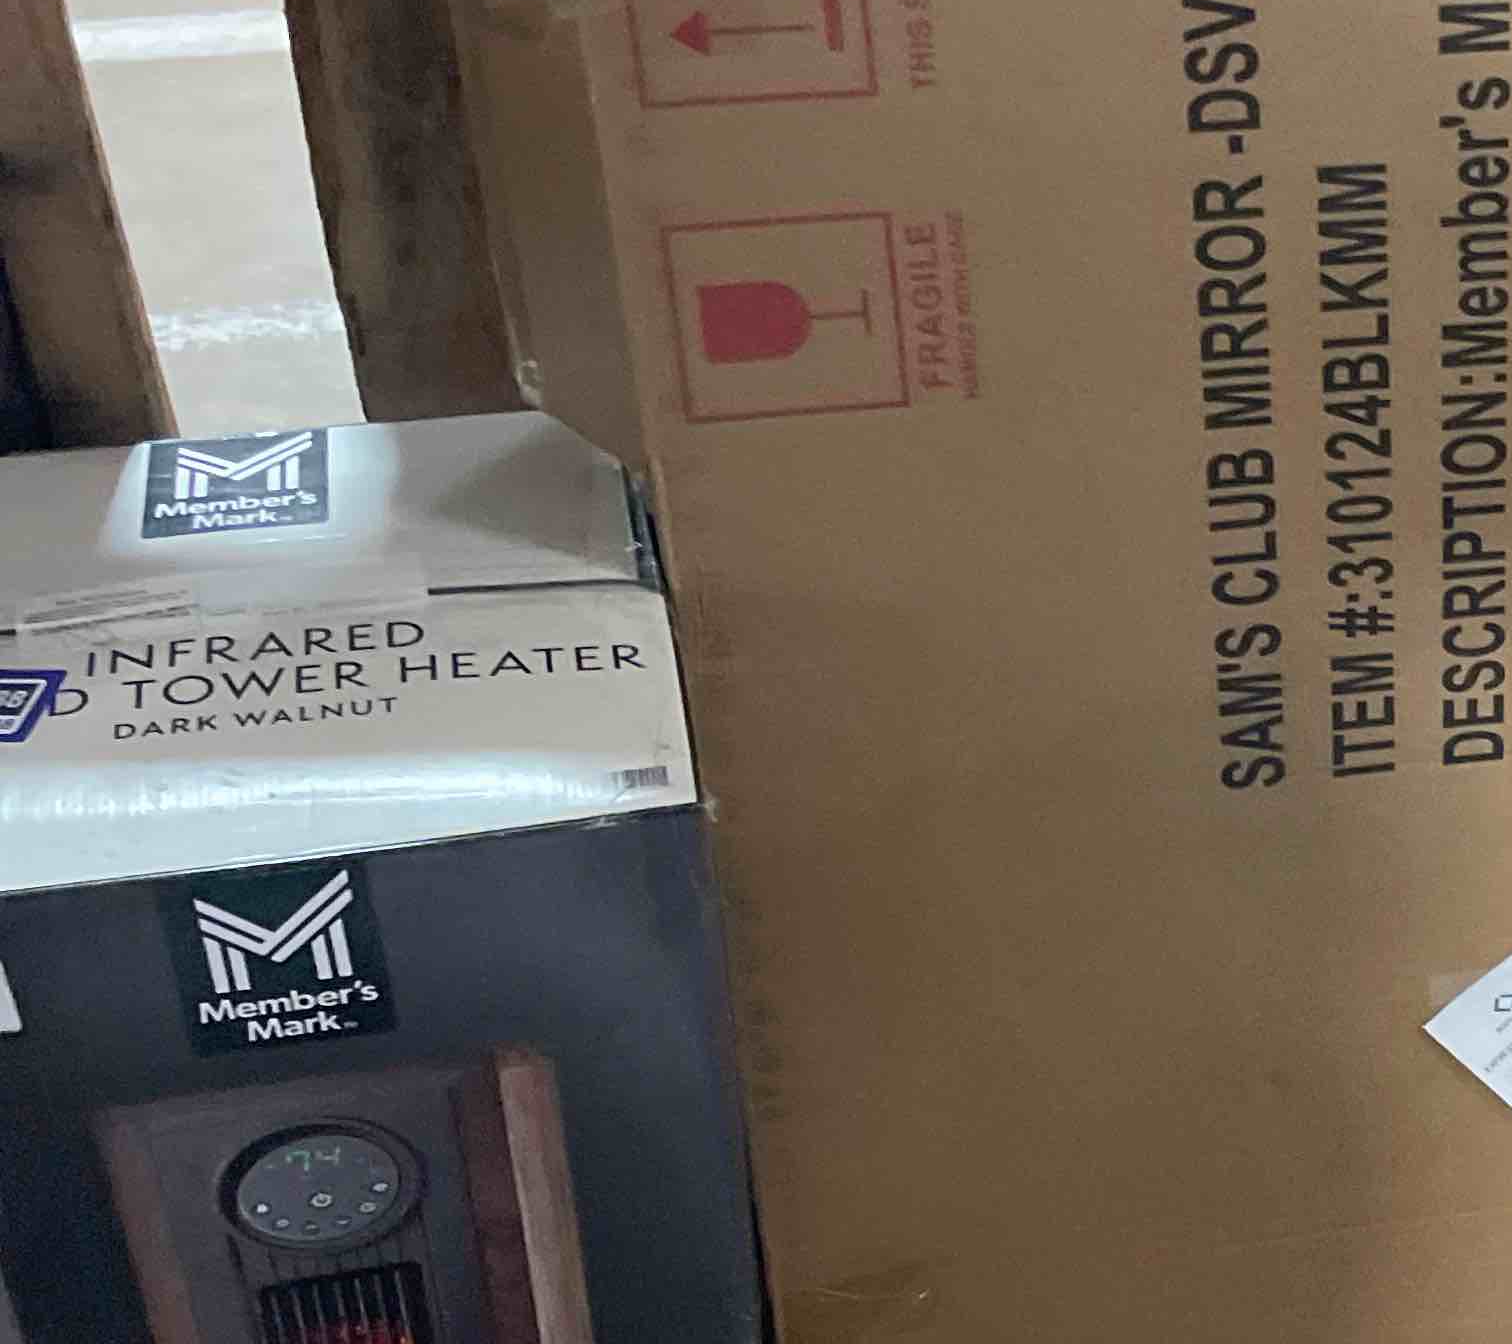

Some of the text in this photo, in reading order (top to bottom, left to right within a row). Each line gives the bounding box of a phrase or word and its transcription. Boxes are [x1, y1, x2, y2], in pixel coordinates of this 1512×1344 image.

[908, 16, 937, 89] THIS
[904, 222, 958, 390] FRAGILE
[1193, 172, 1274, 431] MIRROR
[1316, 161, 1397, 779] ITEM #:310124BLKMM
[154, 490, 318, 520] Member's
[191, 509, 279, 530] Mark
[1207, 447, 1280, 607] CLUB
[86, 620, 425, 678] INFRARED
[122, 661, 371, 711] TOWER
[399, 643, 648, 685] HEATER
[113, 696, 398, 740] DARK WALNUT
[1215, 621, 1287, 791] SAM'S
[197, 976, 380, 1024] Member's
[246, 1010, 343, 1043] Mark
